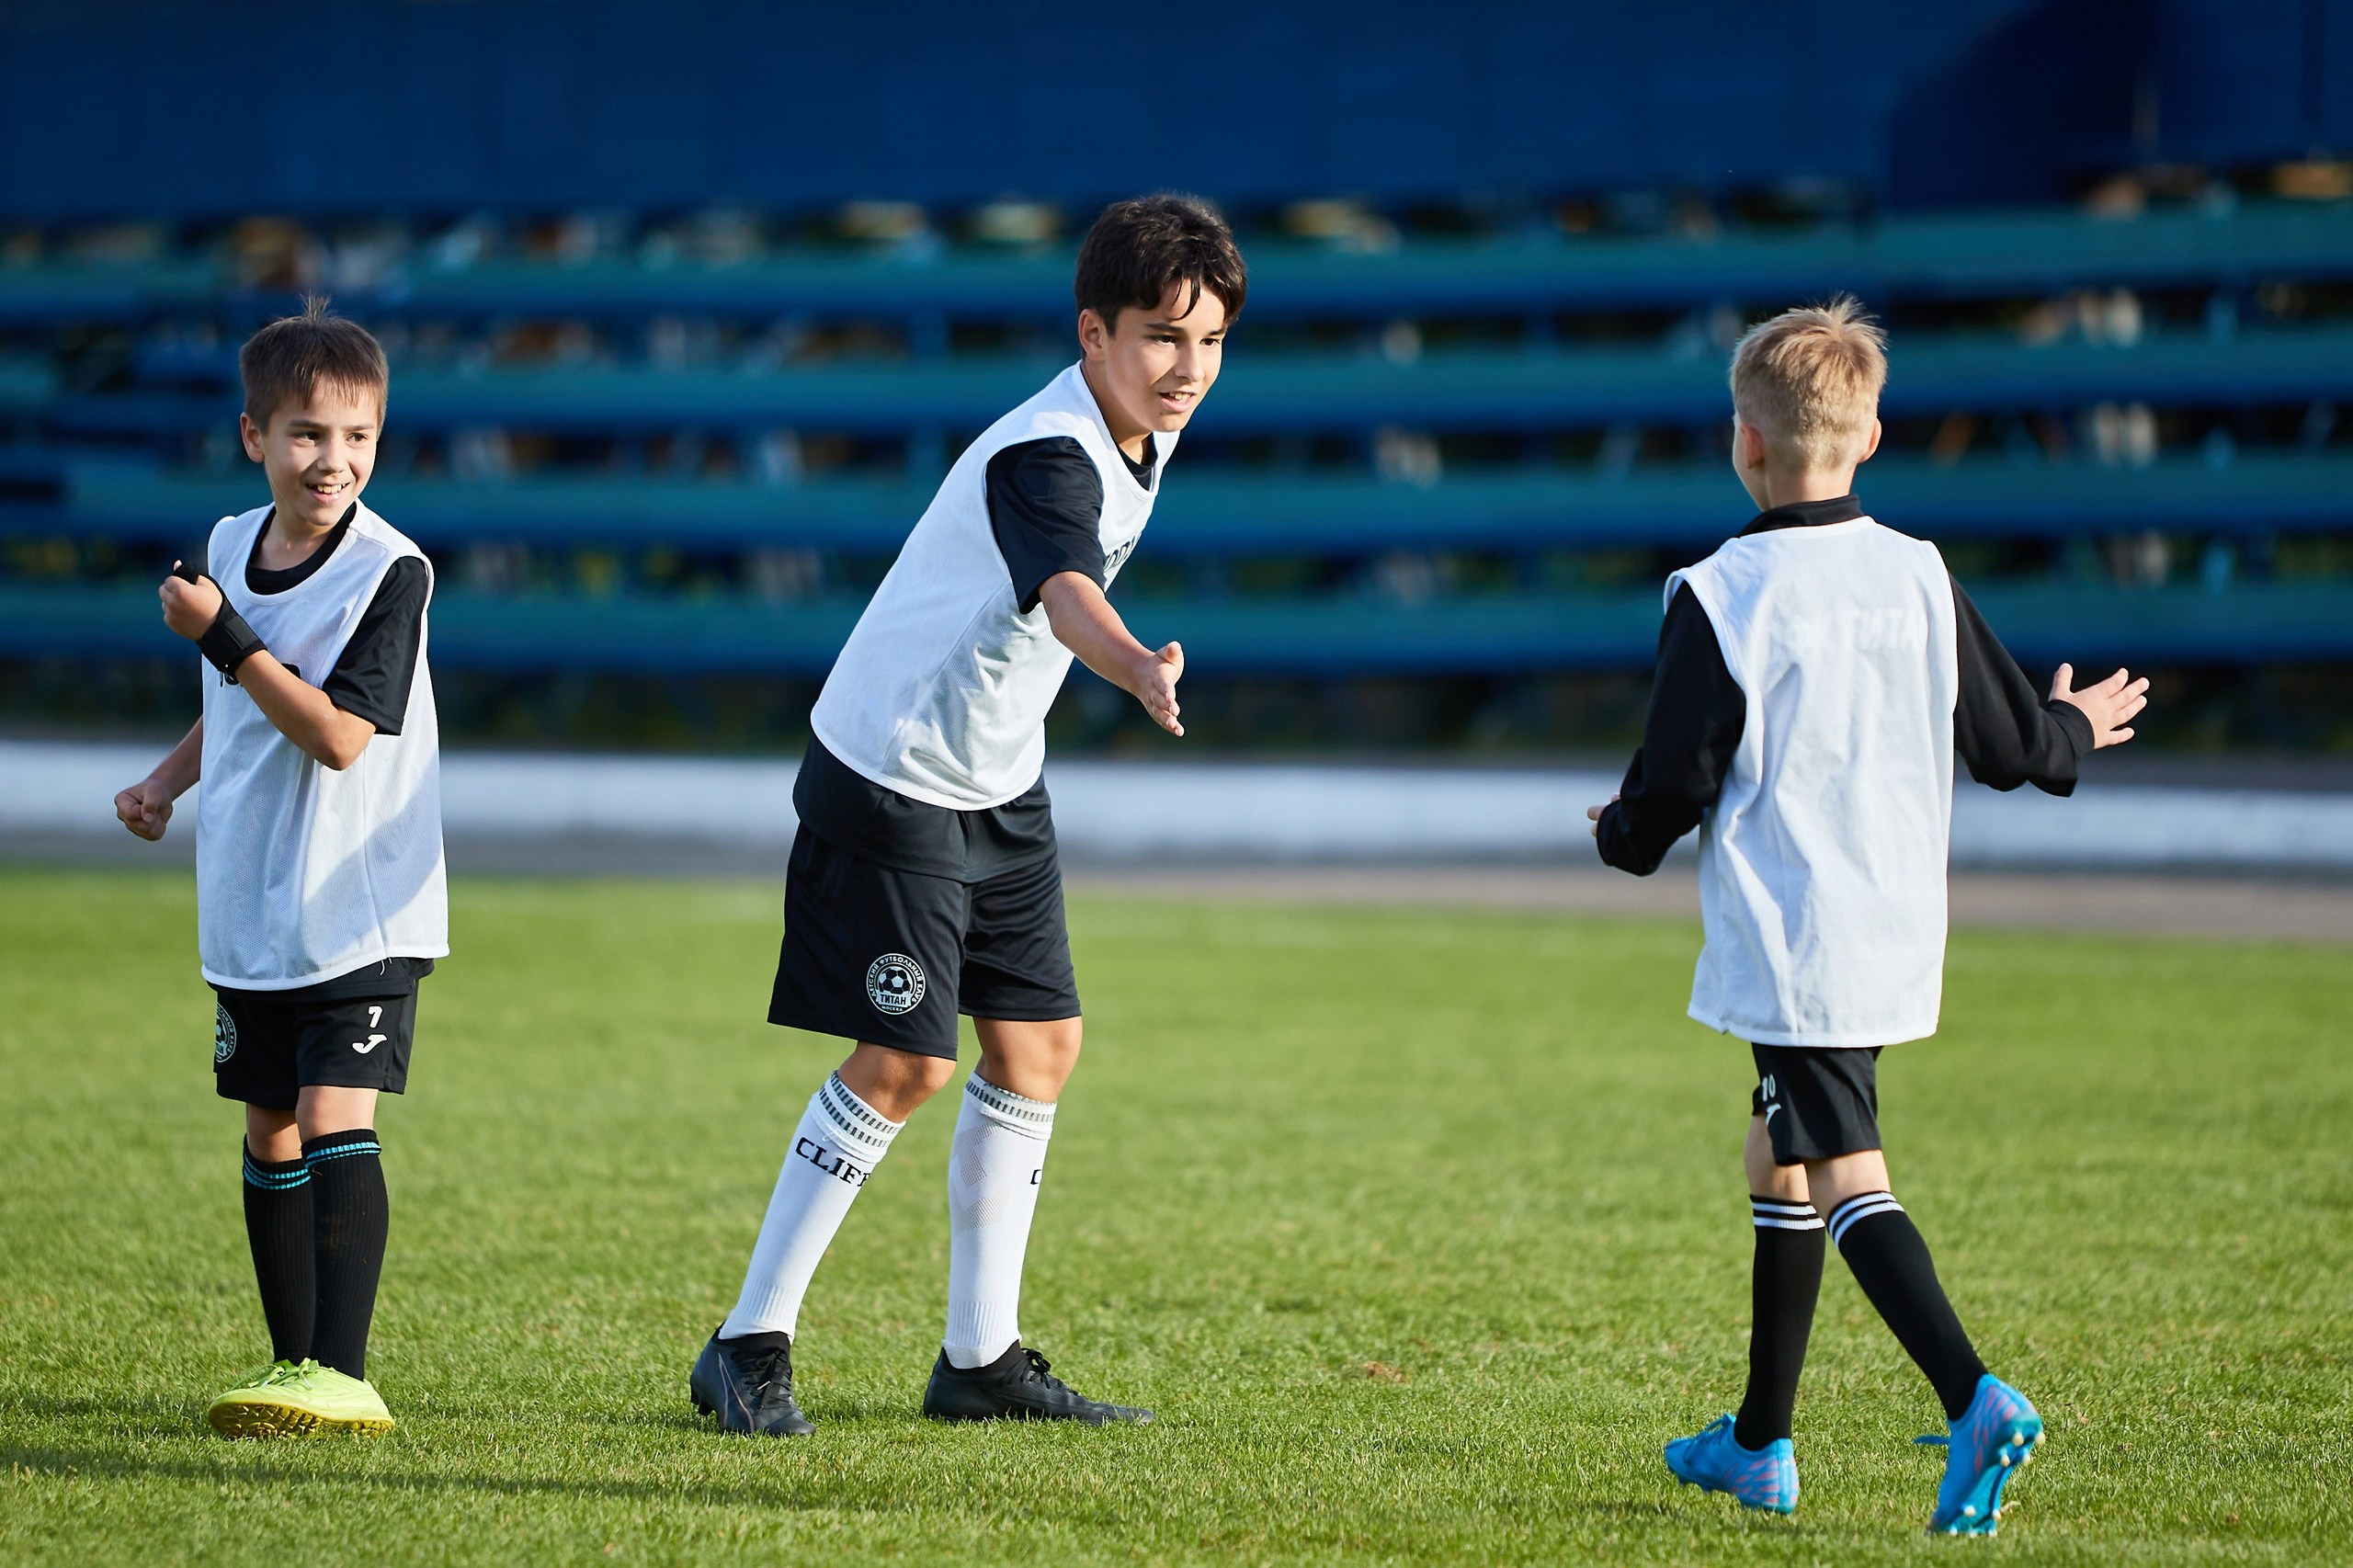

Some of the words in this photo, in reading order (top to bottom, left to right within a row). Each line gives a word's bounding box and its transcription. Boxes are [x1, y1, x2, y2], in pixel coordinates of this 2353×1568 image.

[880, 994, 906, 1006] ТИТАН
[911, 983, 924, 1003] КЛУБ
[368, 1006, 382, 1028] 7
[1761, 1074, 1776, 1102] 10
